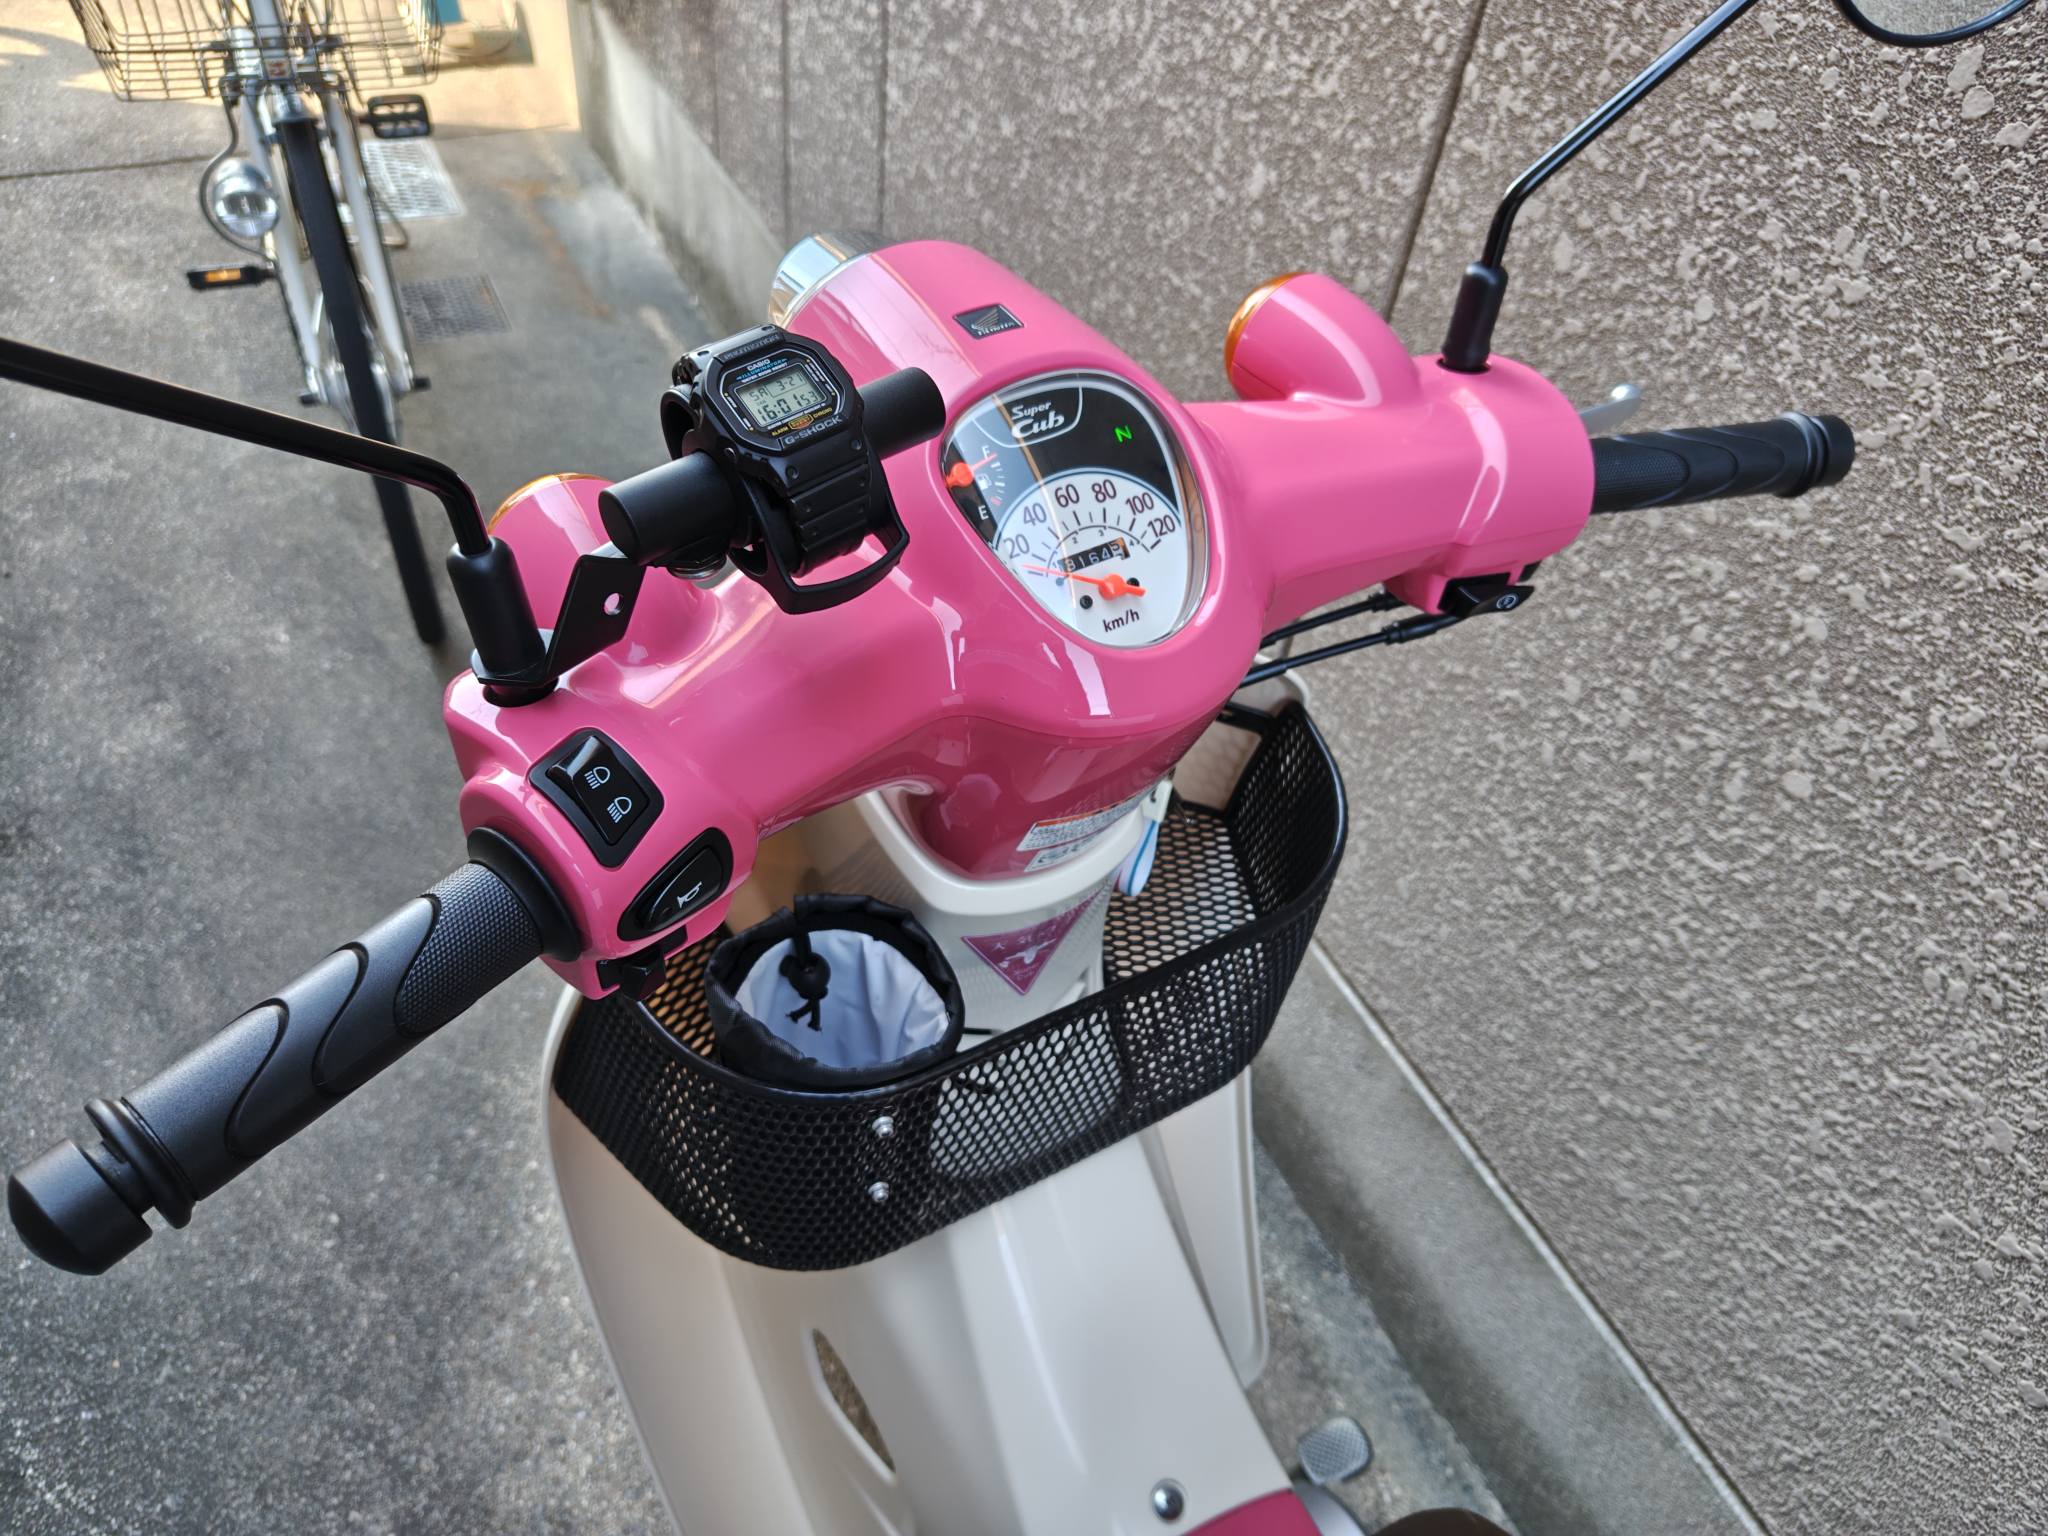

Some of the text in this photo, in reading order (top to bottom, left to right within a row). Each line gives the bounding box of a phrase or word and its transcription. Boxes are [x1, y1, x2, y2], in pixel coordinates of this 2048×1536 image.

[746, 358, 771, 371] CASIO
[1011, 402, 1052, 420] Super
[784, 415, 842, 445] G-SHOCK
[1011, 410, 1065, 439] Cub
[1114, 425, 1133, 443] N
[1054, 483, 1080, 509] 60
[1091, 478, 1118, 504] 80
[1125, 491, 1155, 516] 100
[978, 504, 989, 521] E
[1022, 502, 1047, 527] 40
[1148, 514, 1177, 539] 120
[1003, 533, 1030, 559] 20
[1102, 609, 1140, 633] km/h
